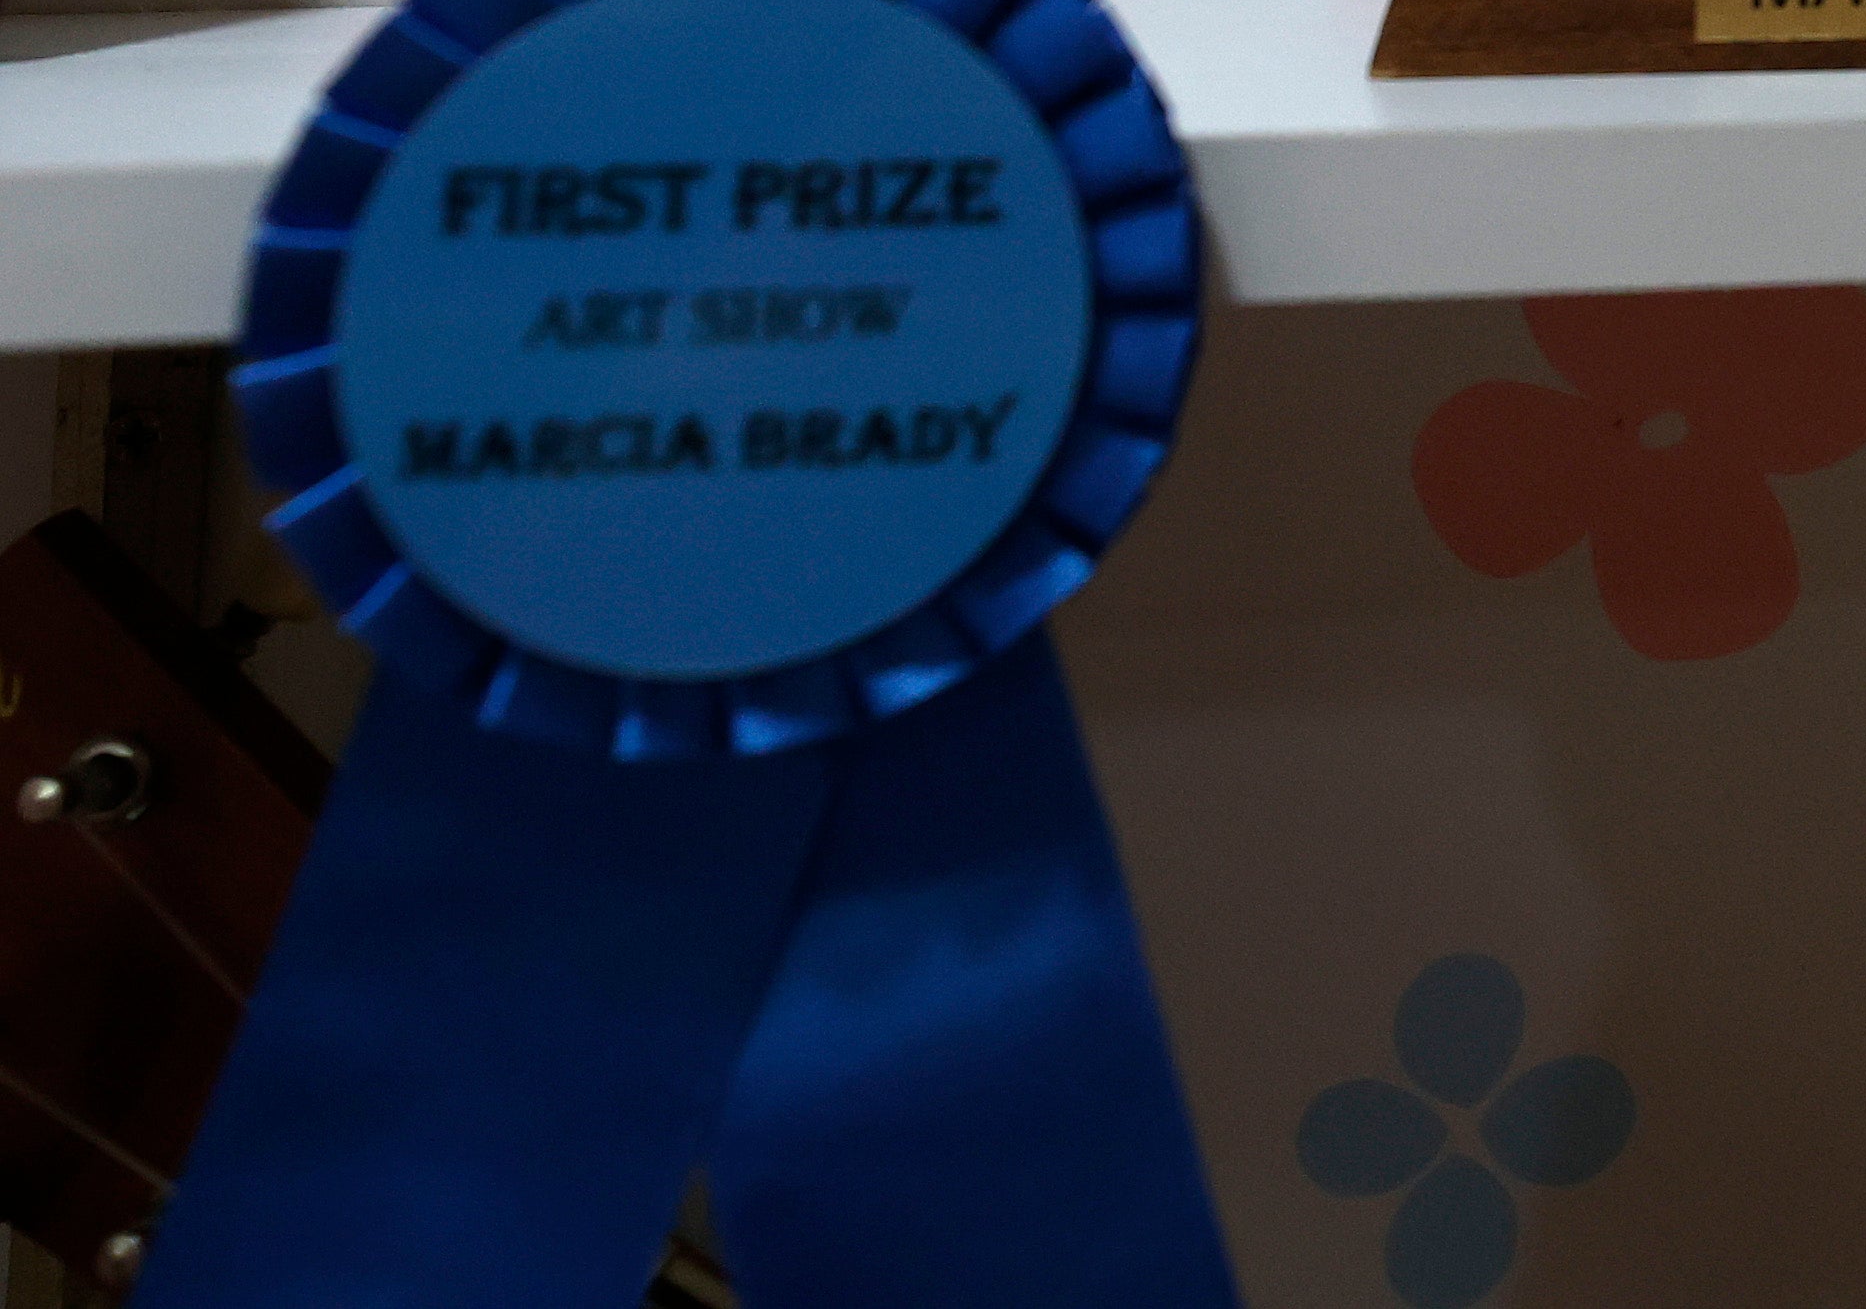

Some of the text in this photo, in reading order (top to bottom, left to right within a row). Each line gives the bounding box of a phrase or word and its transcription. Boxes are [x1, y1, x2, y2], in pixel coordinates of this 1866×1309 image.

[442, 156, 1004, 237] FIRST PRIZE
[523, 283, 912, 350] ART SHOW
[399, 393, 1018, 480] MARCIA BRADY
